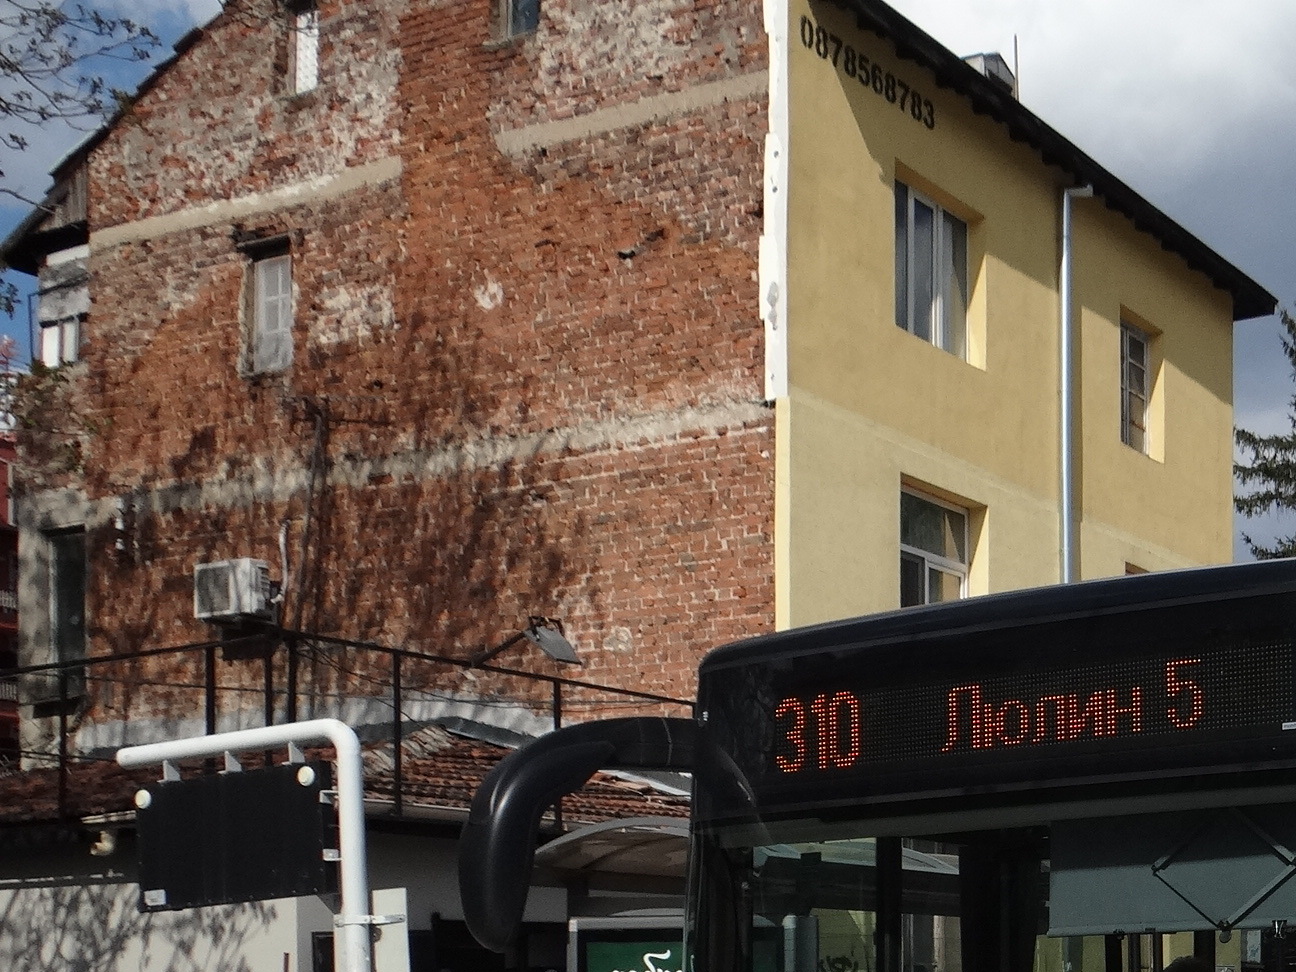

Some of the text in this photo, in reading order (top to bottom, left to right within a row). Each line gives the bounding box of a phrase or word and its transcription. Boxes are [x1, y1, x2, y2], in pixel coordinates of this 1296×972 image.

[800, 14, 935, 130] 0878568783
[775, 658, 1202, 773] 310 Люлин 5
